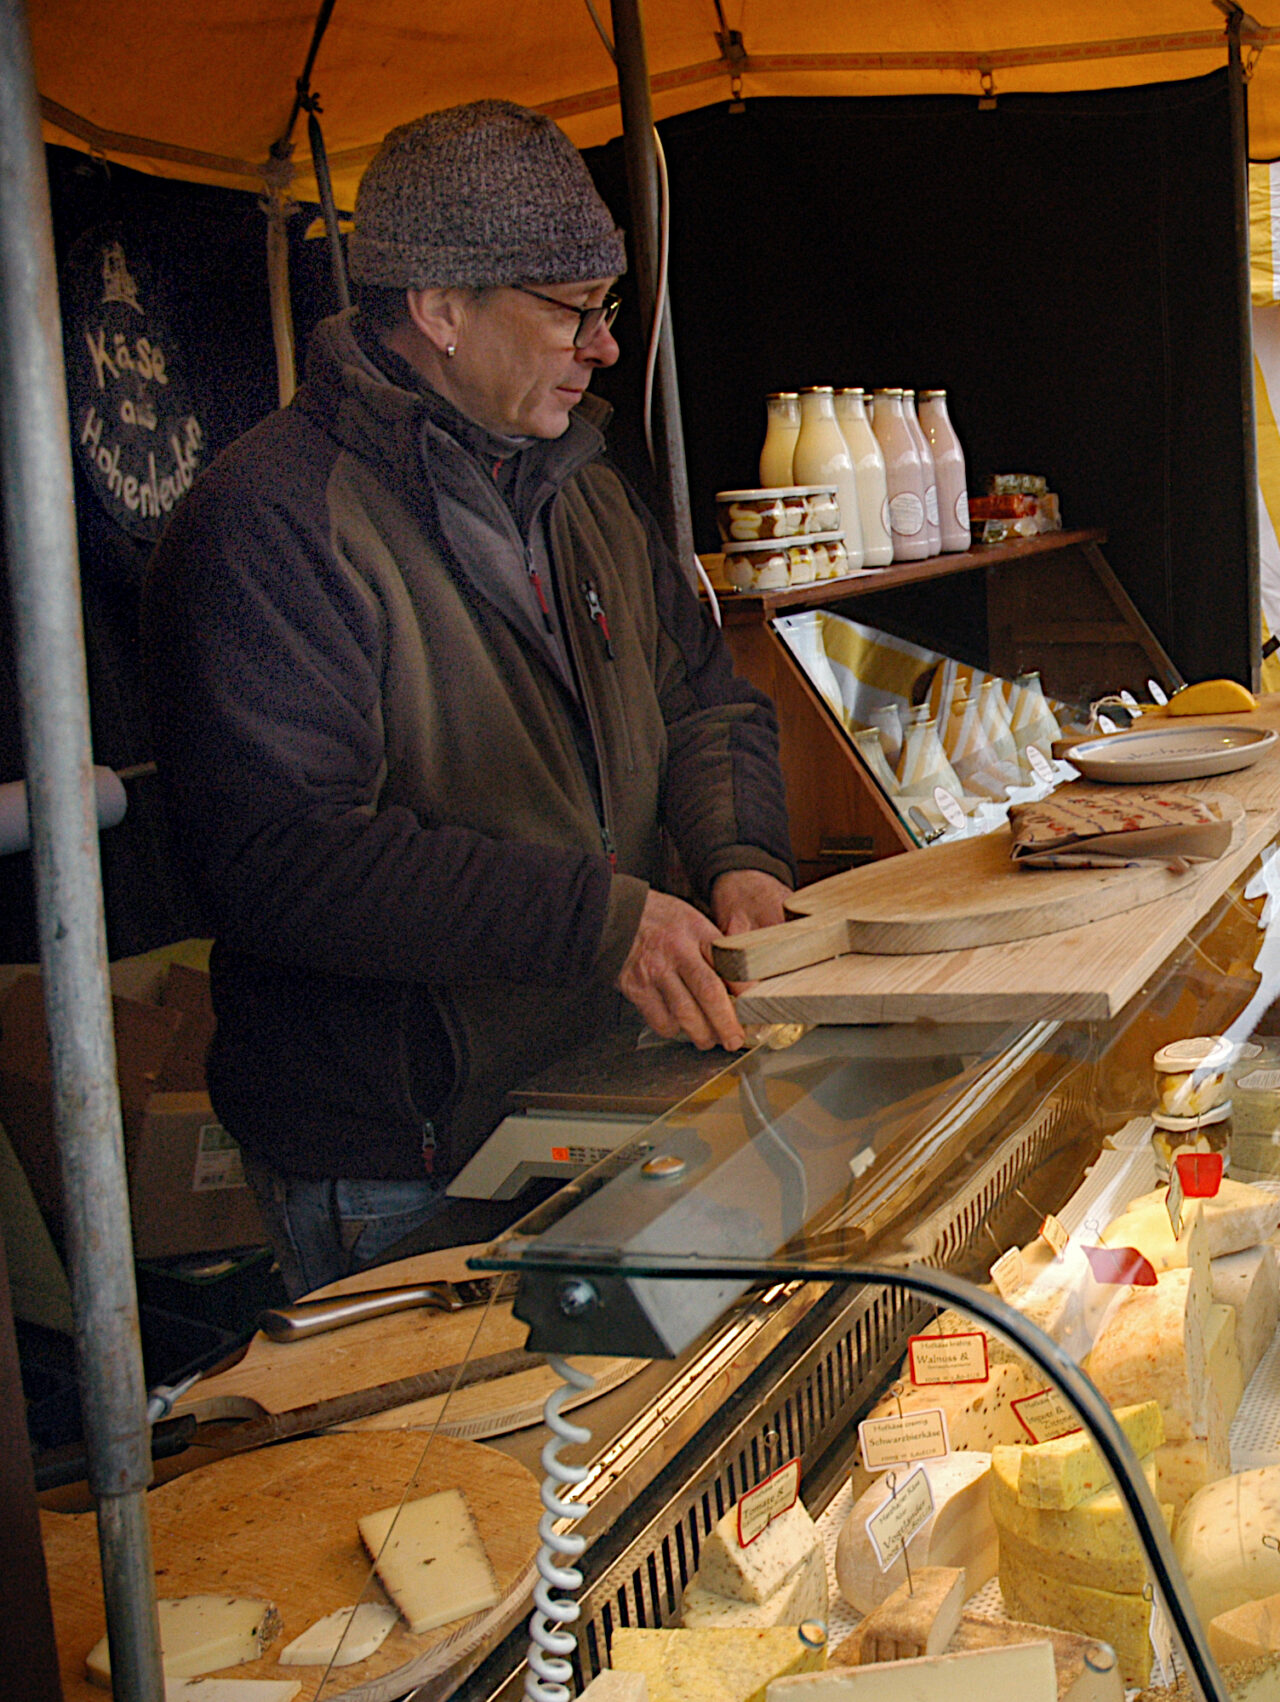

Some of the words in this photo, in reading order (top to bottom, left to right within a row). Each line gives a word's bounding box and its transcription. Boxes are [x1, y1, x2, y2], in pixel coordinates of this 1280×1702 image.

[83, 330, 169, 389] Käse
[916, 1353, 957, 1365] Walnuss
[868, 1430, 941, 1447] Schwarzbierkäse
